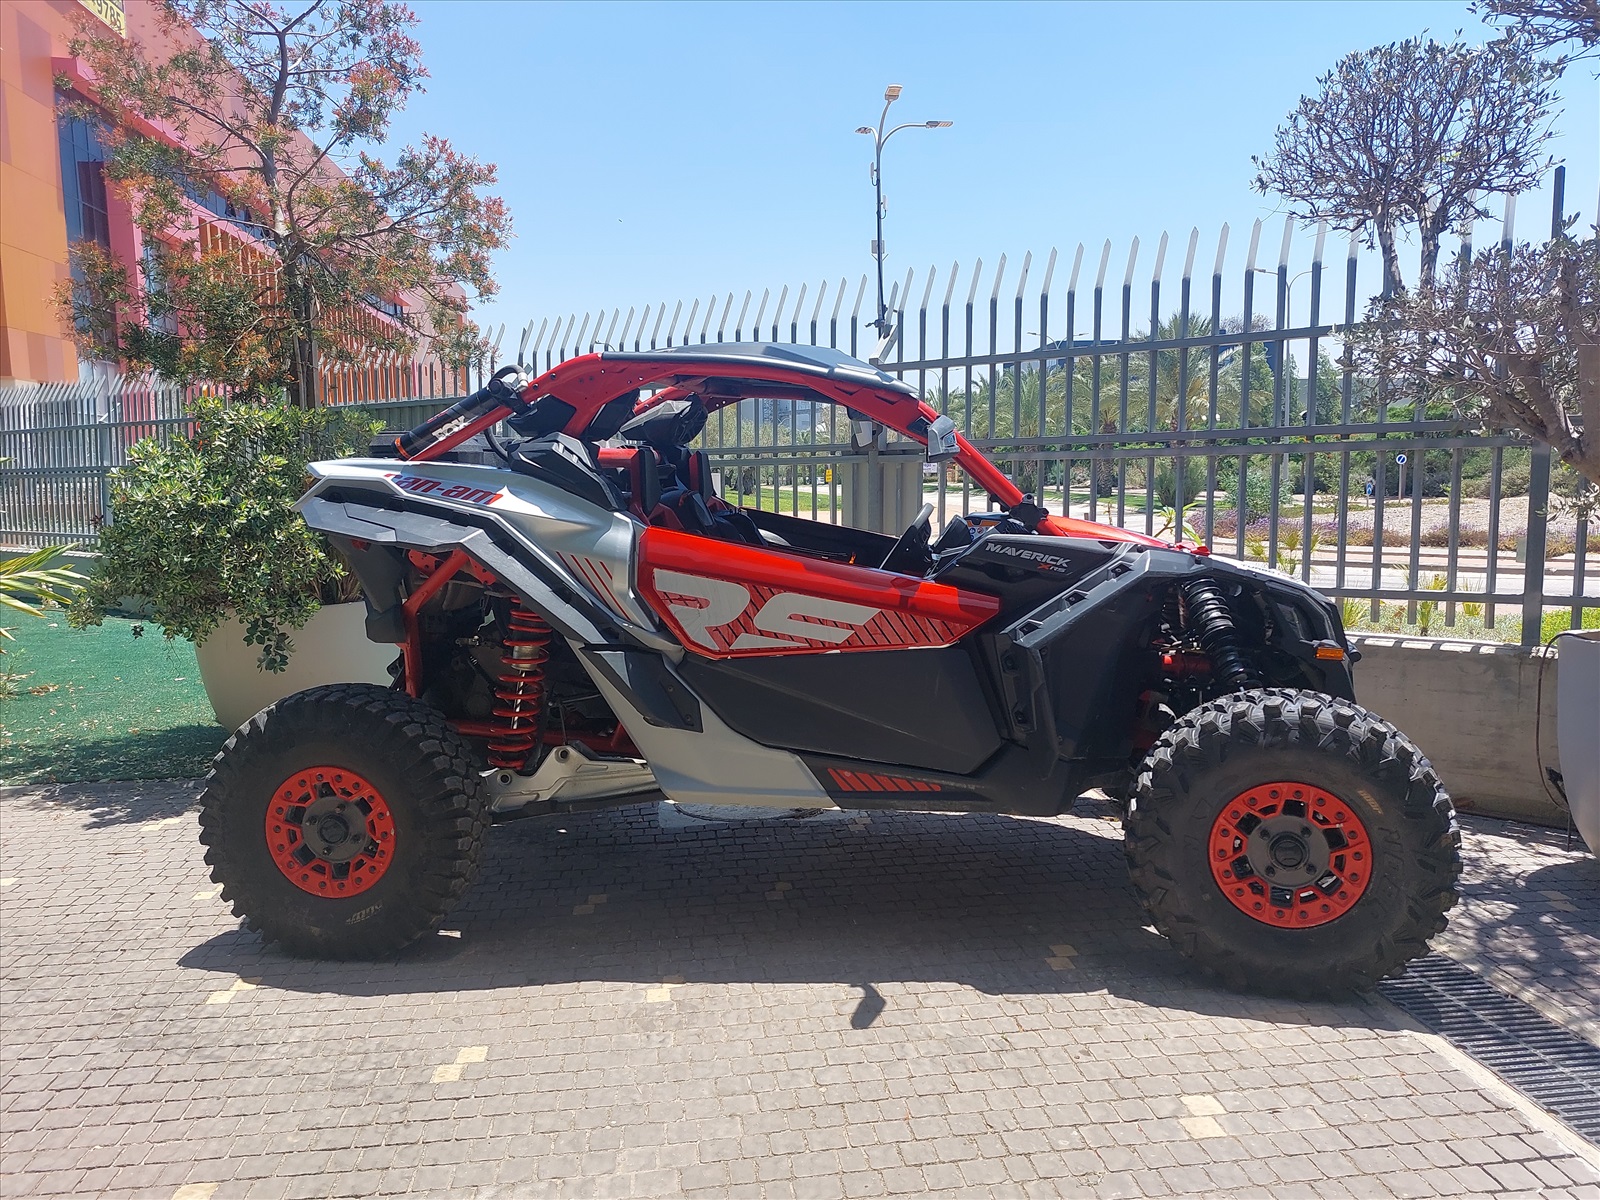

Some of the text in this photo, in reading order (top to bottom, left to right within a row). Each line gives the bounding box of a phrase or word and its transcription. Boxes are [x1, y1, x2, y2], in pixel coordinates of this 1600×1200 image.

[92, 0, 122, 29] 9785
[431, 415, 471, 441] FOX
[985, 542, 1071, 567] MAVERICK
